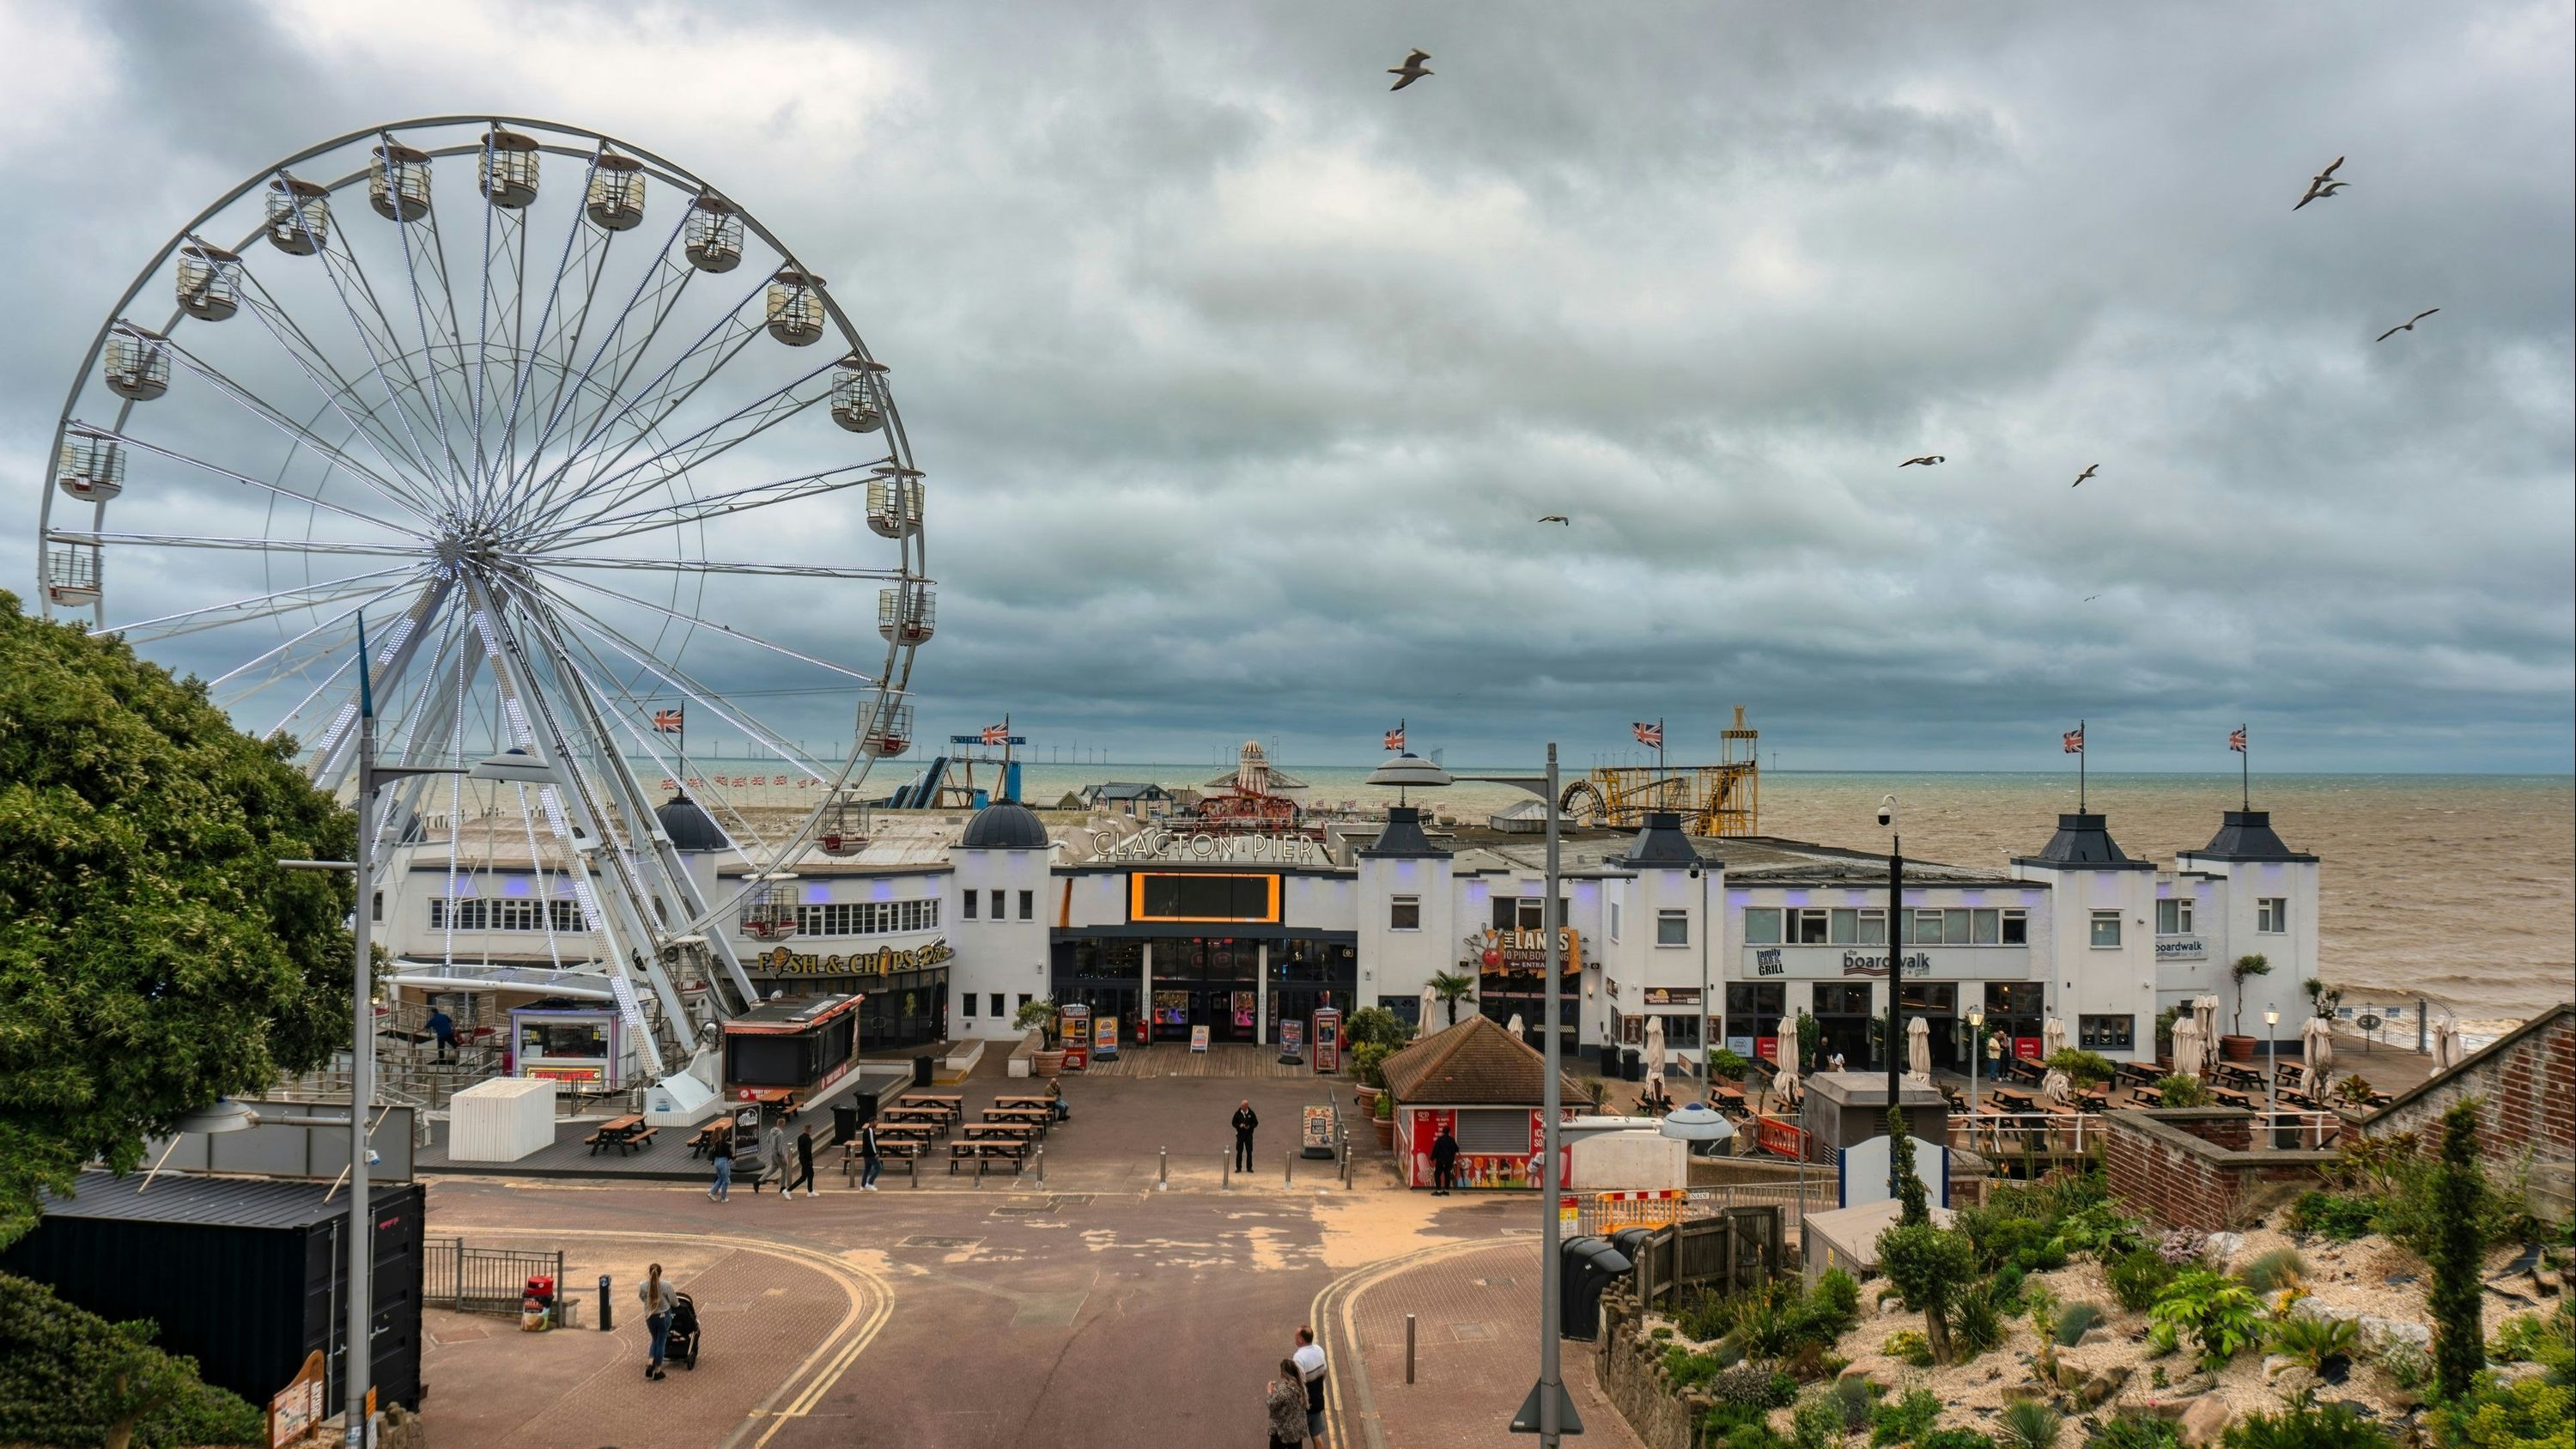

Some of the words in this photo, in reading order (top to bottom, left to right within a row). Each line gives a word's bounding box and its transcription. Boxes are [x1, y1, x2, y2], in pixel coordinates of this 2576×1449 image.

[1092, 831, 1234, 857] CLACTON
[1254, 834, 1314, 859] PIER
[1504, 930, 1515, 949] THE
[1515, 932, 1570, 951] LANS
[825, 954, 845, 976] &
[1504, 951, 1512, 960] 10
[1514, 951, 1528, 960] PIN
[1530, 951, 1570, 962] BOWNG
[1759, 963, 1785, 977] GRILL
